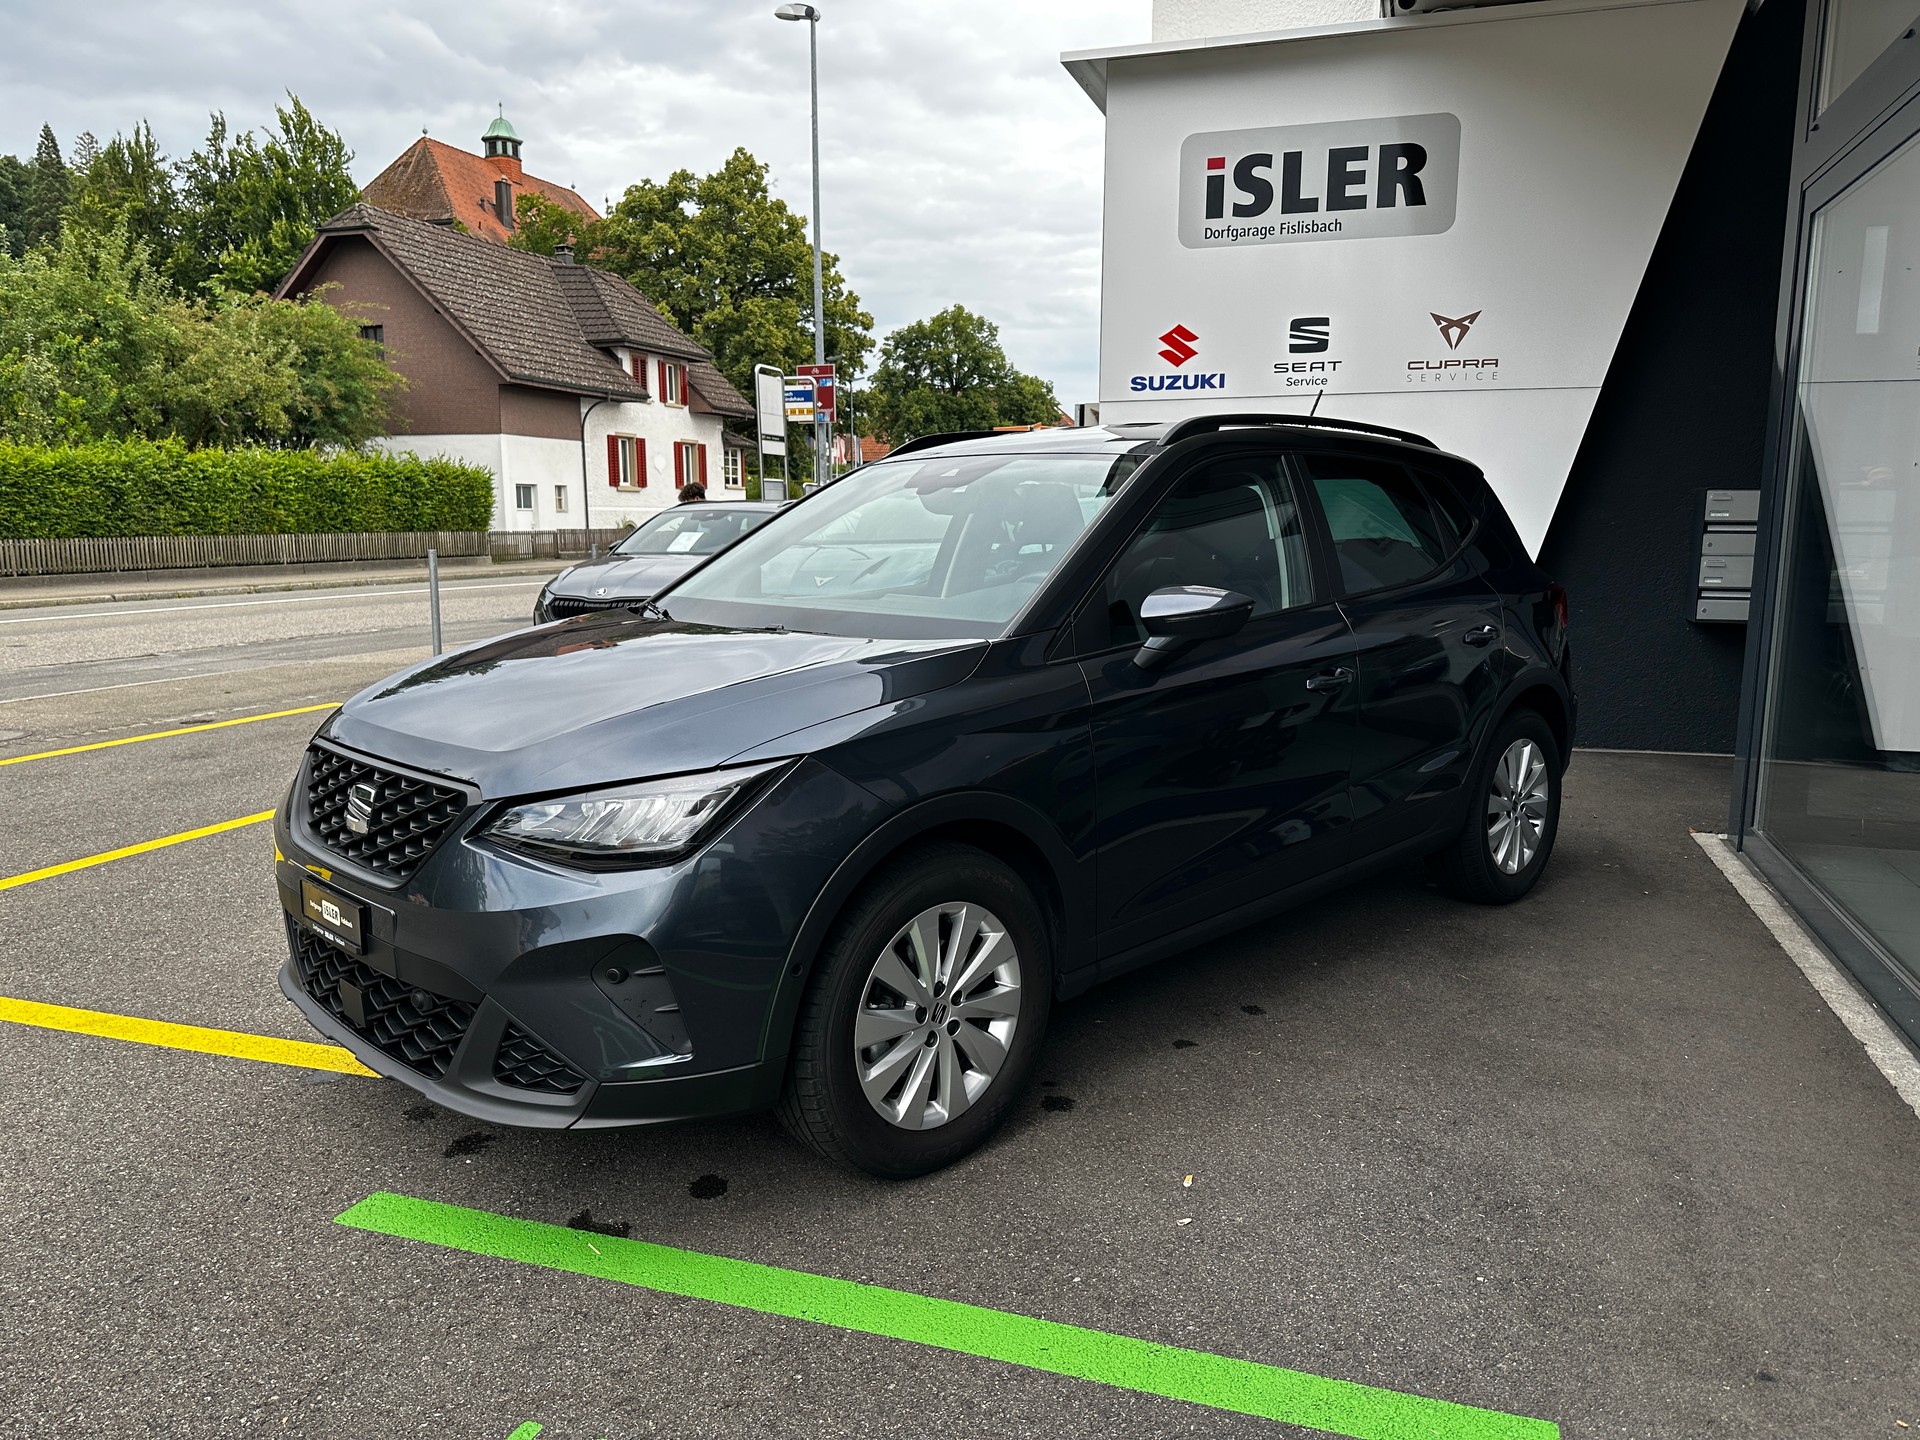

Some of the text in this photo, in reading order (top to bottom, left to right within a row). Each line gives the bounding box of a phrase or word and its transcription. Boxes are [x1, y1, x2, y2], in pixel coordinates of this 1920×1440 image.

[1205, 142, 1428, 220] iSLER
[1204, 218, 1342, 242] Dorfgarage Fislisbach
[1273, 360, 1343, 374] SEAT
[1407, 358, 1499, 371] CUPRA
[1130, 373, 1226, 392] SUZUKI
[1286, 376, 1328, 387] Service
[1406, 371, 1499, 383] SERVICE
